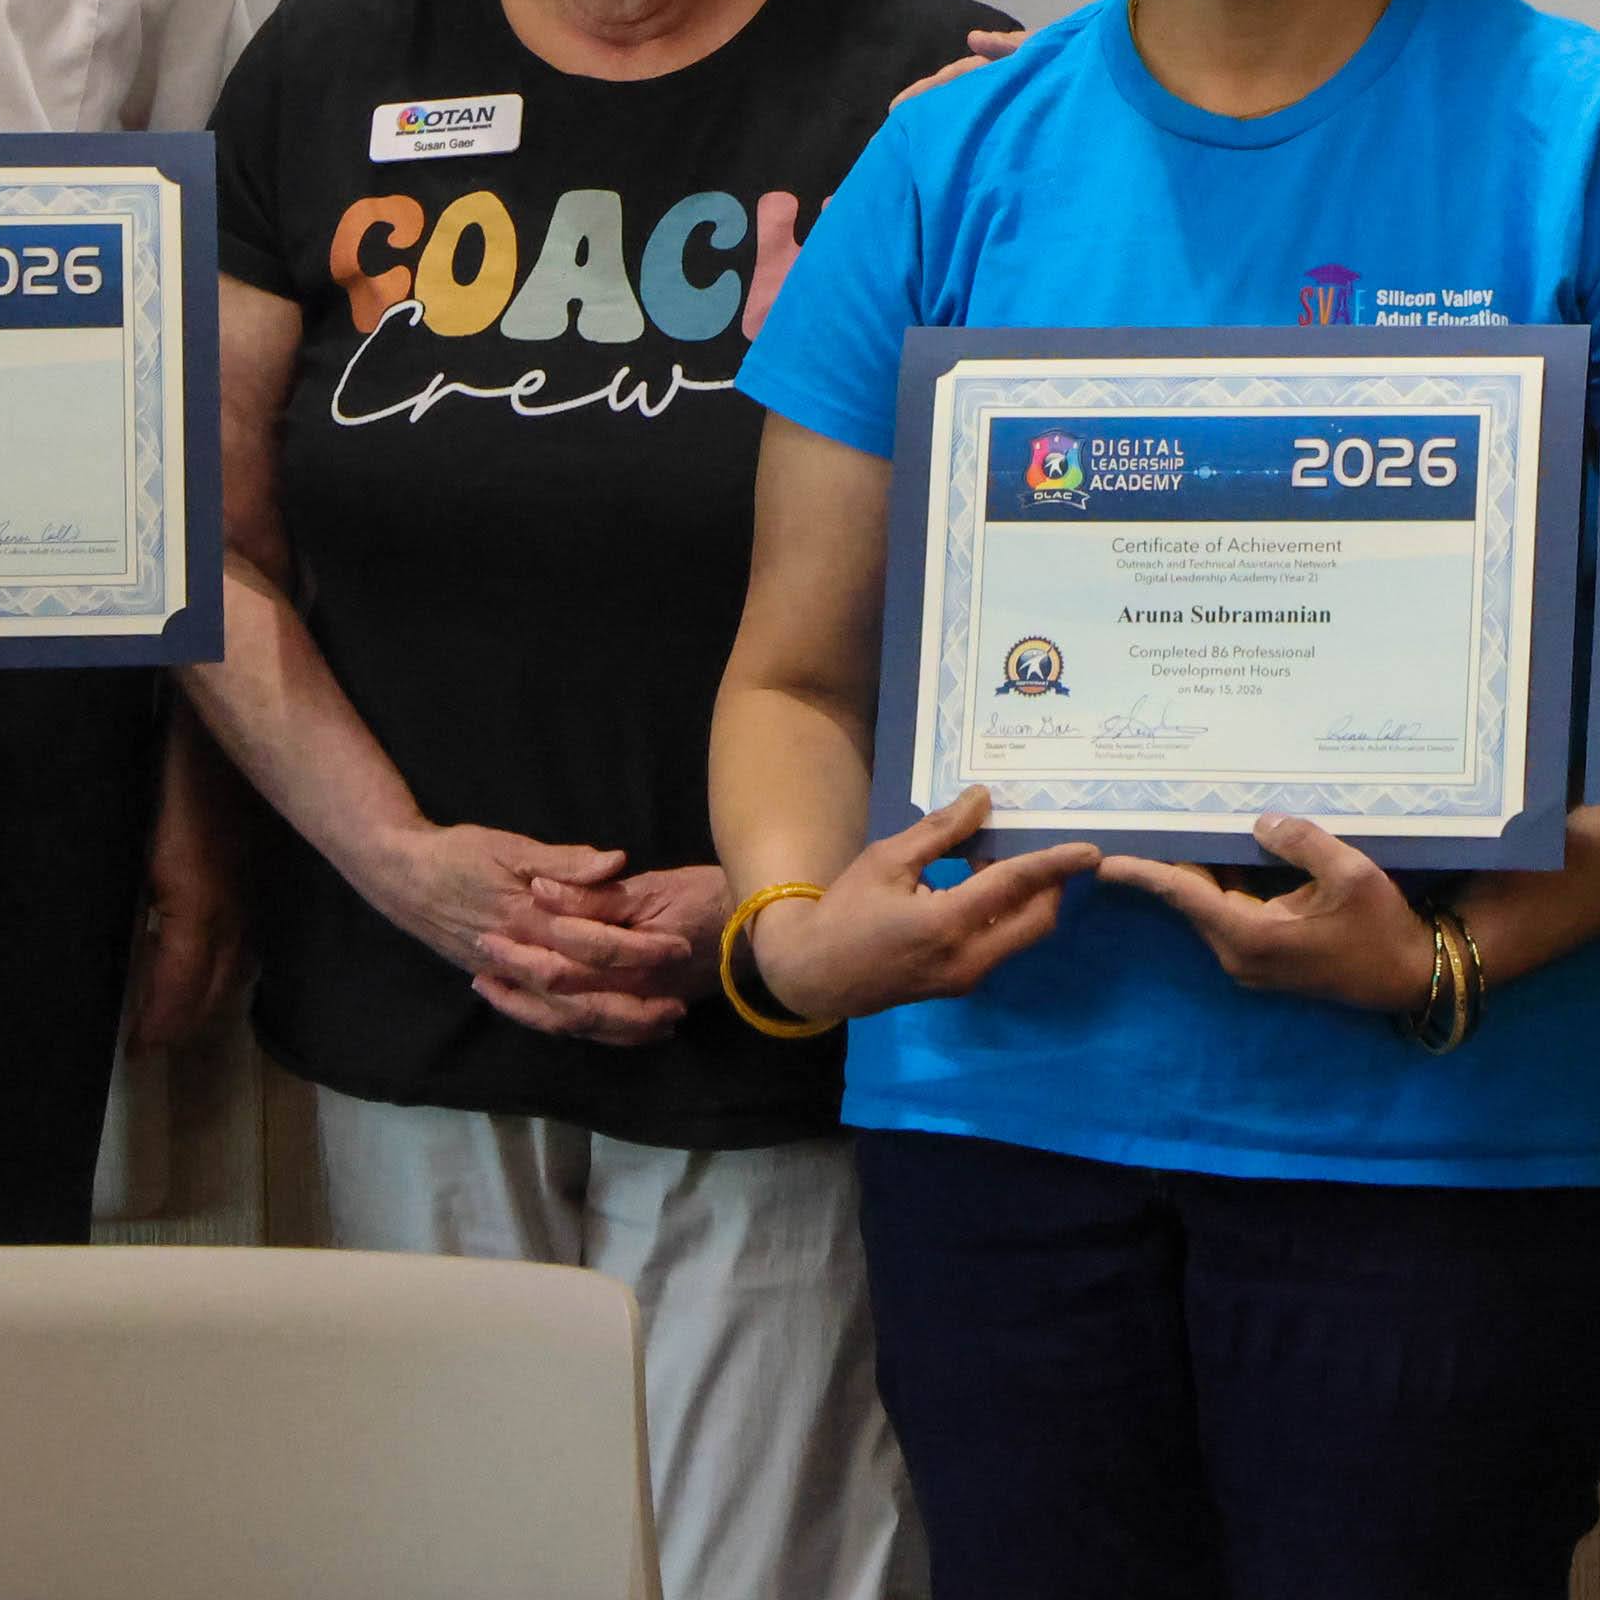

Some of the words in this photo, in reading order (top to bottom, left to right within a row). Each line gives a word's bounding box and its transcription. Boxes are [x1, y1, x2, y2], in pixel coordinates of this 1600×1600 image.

[423, 106, 496, 127] OTAN
[413, 140, 446, 152] Susan
[449, 138, 475, 150] Gaer
[1375, 289, 1436, 307] Silicon
[1442, 289, 1493, 307] Valley
[1375, 311, 1422, 327] Adult
[332, 300, 740, 427] Crew
[1092, 439, 1184, 456] DIGITAL
[1091, 458, 1184, 471] LEADERSHIP
[1290, 437, 1458, 488] 2026
[1089, 474, 1183, 491] ACADEMY
[1111, 537, 1200, 554] Certificate
[1205, 536, 1223, 554] of
[1227, 537, 1342, 553] Achievement
[1116, 559, 1164, 569] Outreach
[1166, 559, 1186, 569] and
[1188, 559, 1236, 569] Technical
[1238, 559, 1291, 569] Assistance
[1294, 559, 1337, 569] Network
[1134, 573, 1168, 585] Digital
[1170, 573, 1226, 585] Leadership
[1229, 573, 1278, 585] Academy
[1117, 606, 1184, 624] Aruna
[1190, 605, 1332, 624] Subramanian
[1129, 646, 1208, 661] Completed
[1211, 646, 1229, 659] 86
[1233, 645, 1315, 659] Professional
[1151, 664, 1246, 679] Development
[1250, 664, 1291, 678] Hours
[1178, 686, 1191, 695] on
[1193, 685, 1215, 697] May
[1218, 685, 1234, 696] 15,
[1236, 685, 1263, 695] 2026
